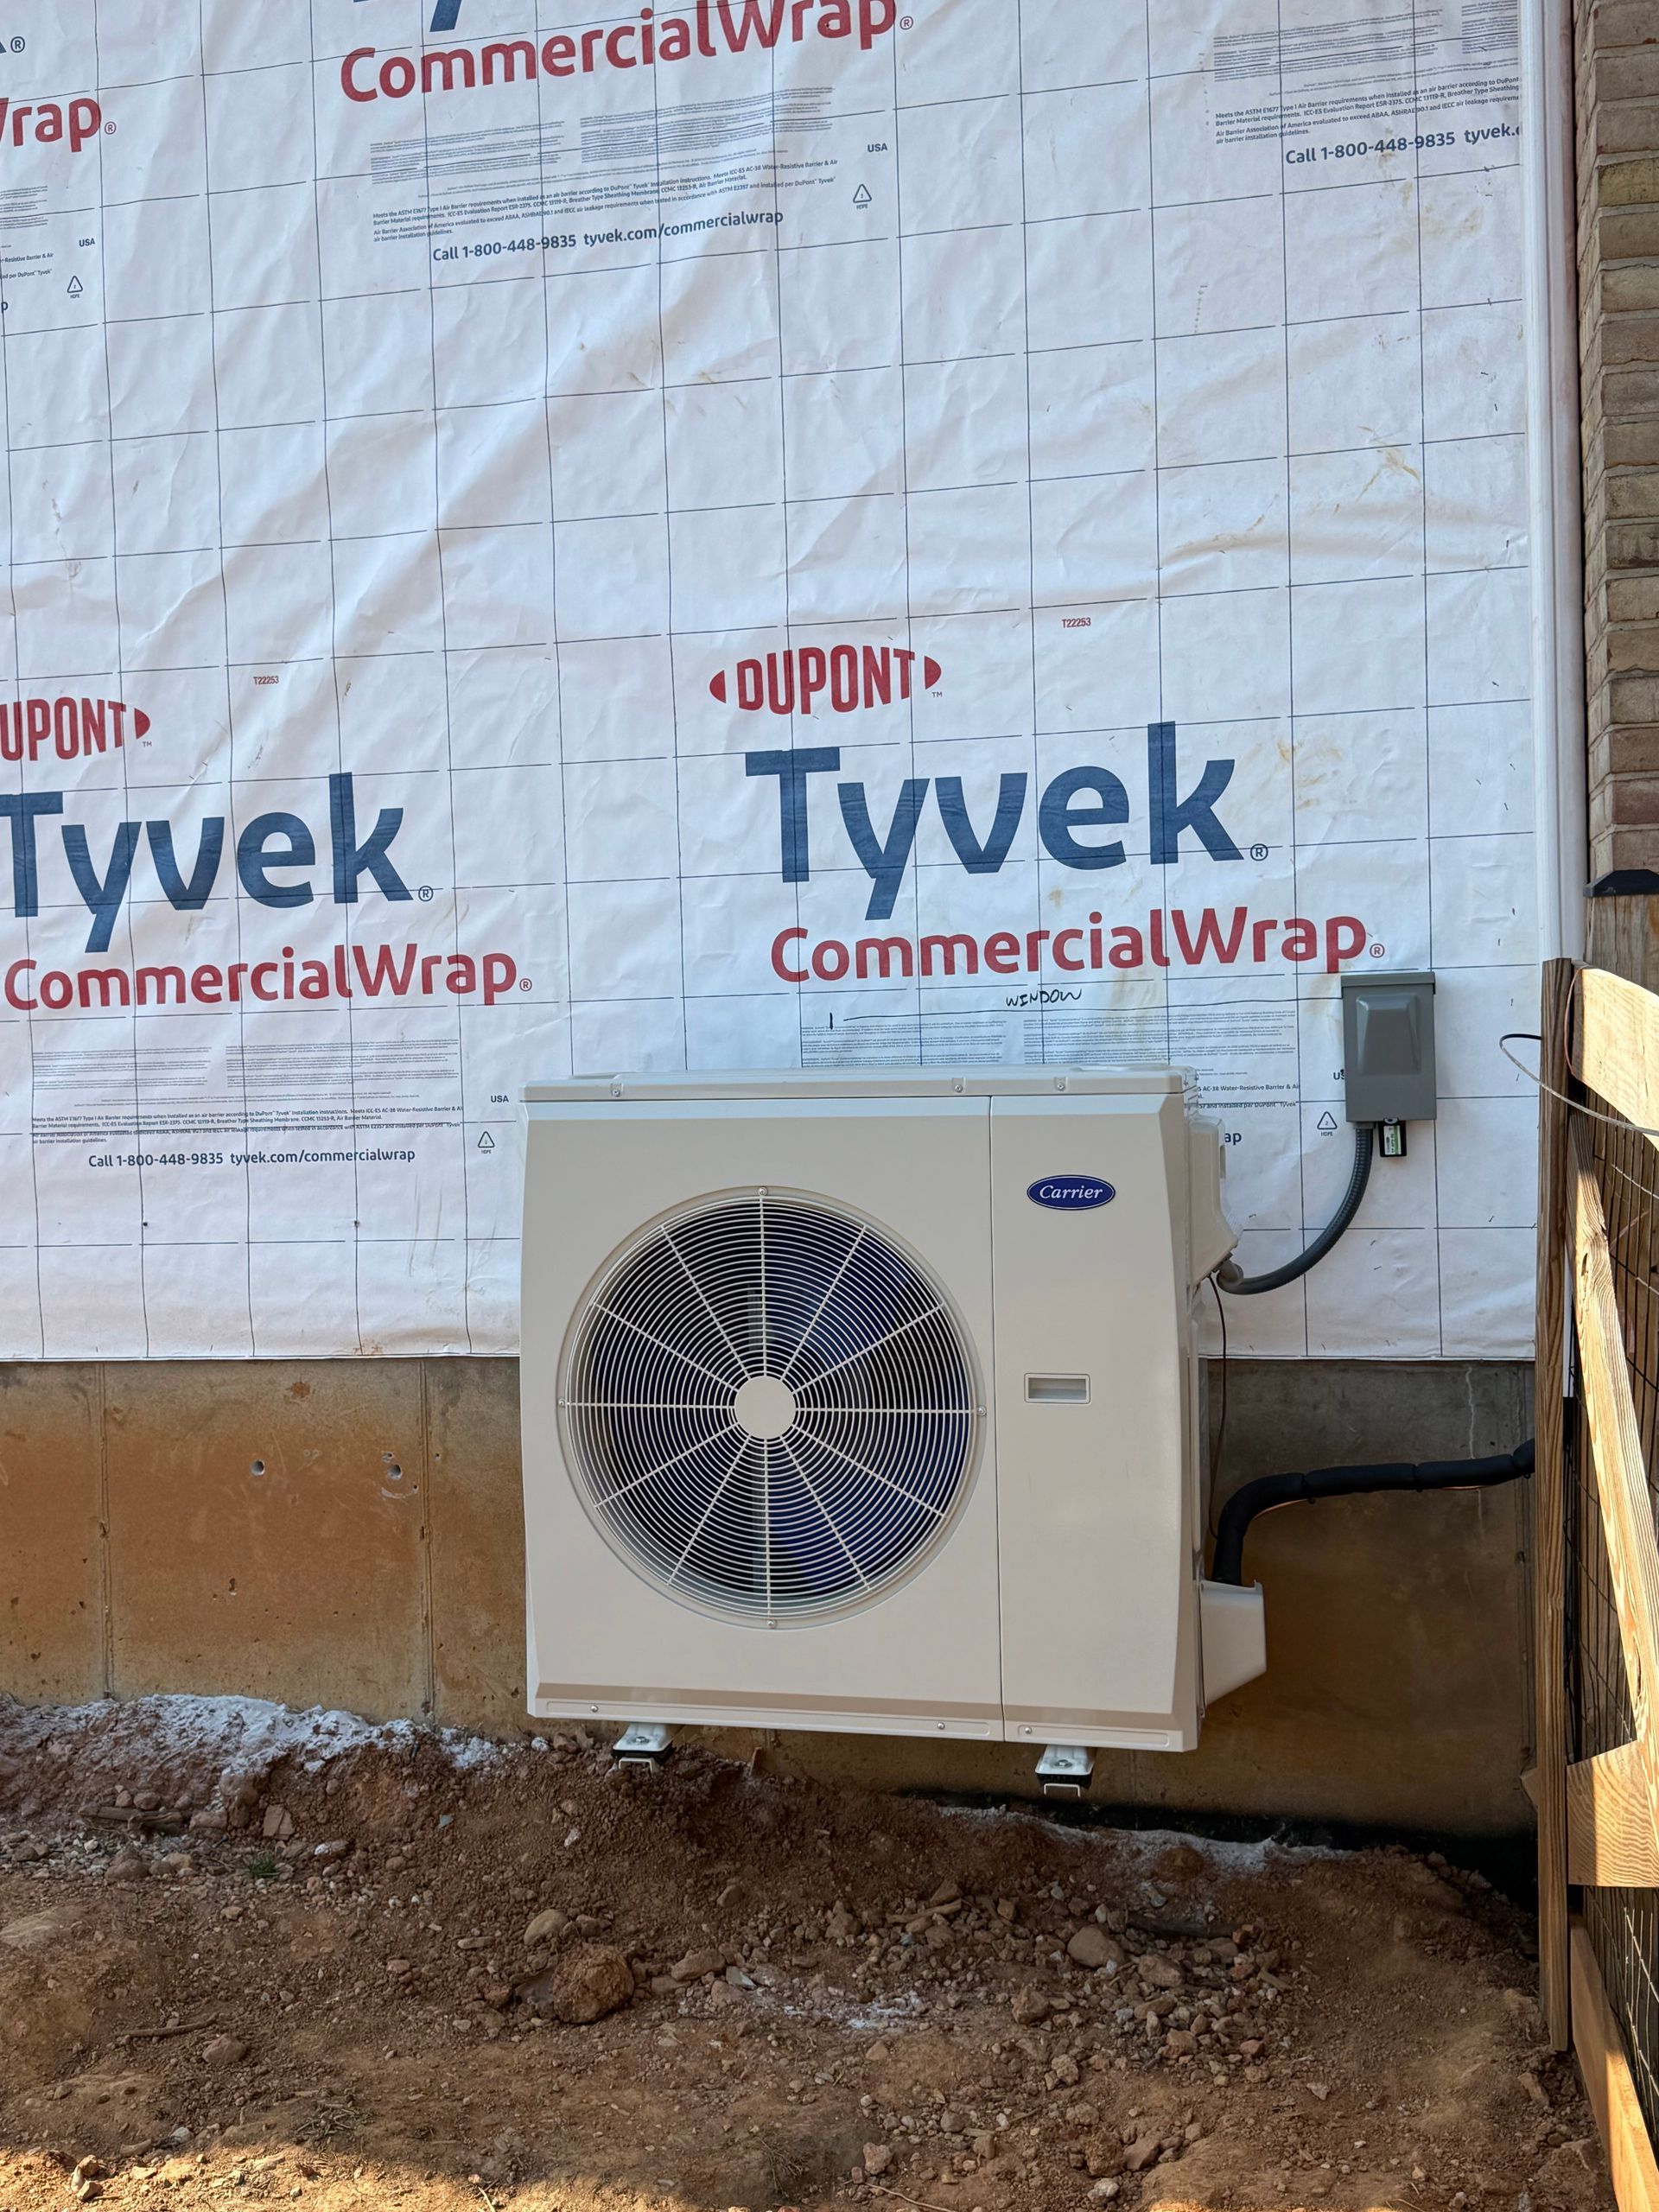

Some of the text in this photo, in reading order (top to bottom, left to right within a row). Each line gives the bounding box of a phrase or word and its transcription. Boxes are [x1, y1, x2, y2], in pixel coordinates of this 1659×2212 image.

[1328, 96, 1367, 105] requirements
[1386, 90, 1411, 99] installed
[1459, 79, 1487, 88] according
[1261, 111, 1301, 121] requirements.
[1323, 105, 1353, 113] Evaluation
[1355, 102, 1374, 111] Report
[1404, 95, 1421, 104] CCMC
[1446, 88, 1473, 97] Breather
[1489, 83, 1519, 92] Sheathing
[1246, 124, 1279, 133] Association
[1313, 117, 1341, 125] evaluated
[1390, 107, 1414, 116] ASHRAE
[1278, 128, 1309, 137] guidelines.
[867, 143, 888, 153] USA
[1286, 145, 1316, 164] Call
[1320, 130, 1455, 160] 1-800-448-9835
[79, 238, 96, 247] USA
[433, 211, 784, 262] Call 1-800-448-9835 tyvek.com/commercialwrap
[1061, 617, 1092, 629] T22253
[252, 676, 280, 685] T22253
[736, 644, 917, 715] DUPONT
[0, 696, 127, 761] UPONT
[1005, 988, 1083, 1007] WINDOW
[1333, 1070, 1345, 1080] US
[490, 1095, 510, 1103] USA
[89, 1148, 416, 1166] Call 1-800-448-9835 tyvek.com/commercialwrap
[1039, 1183, 1103, 1202] Carrier
